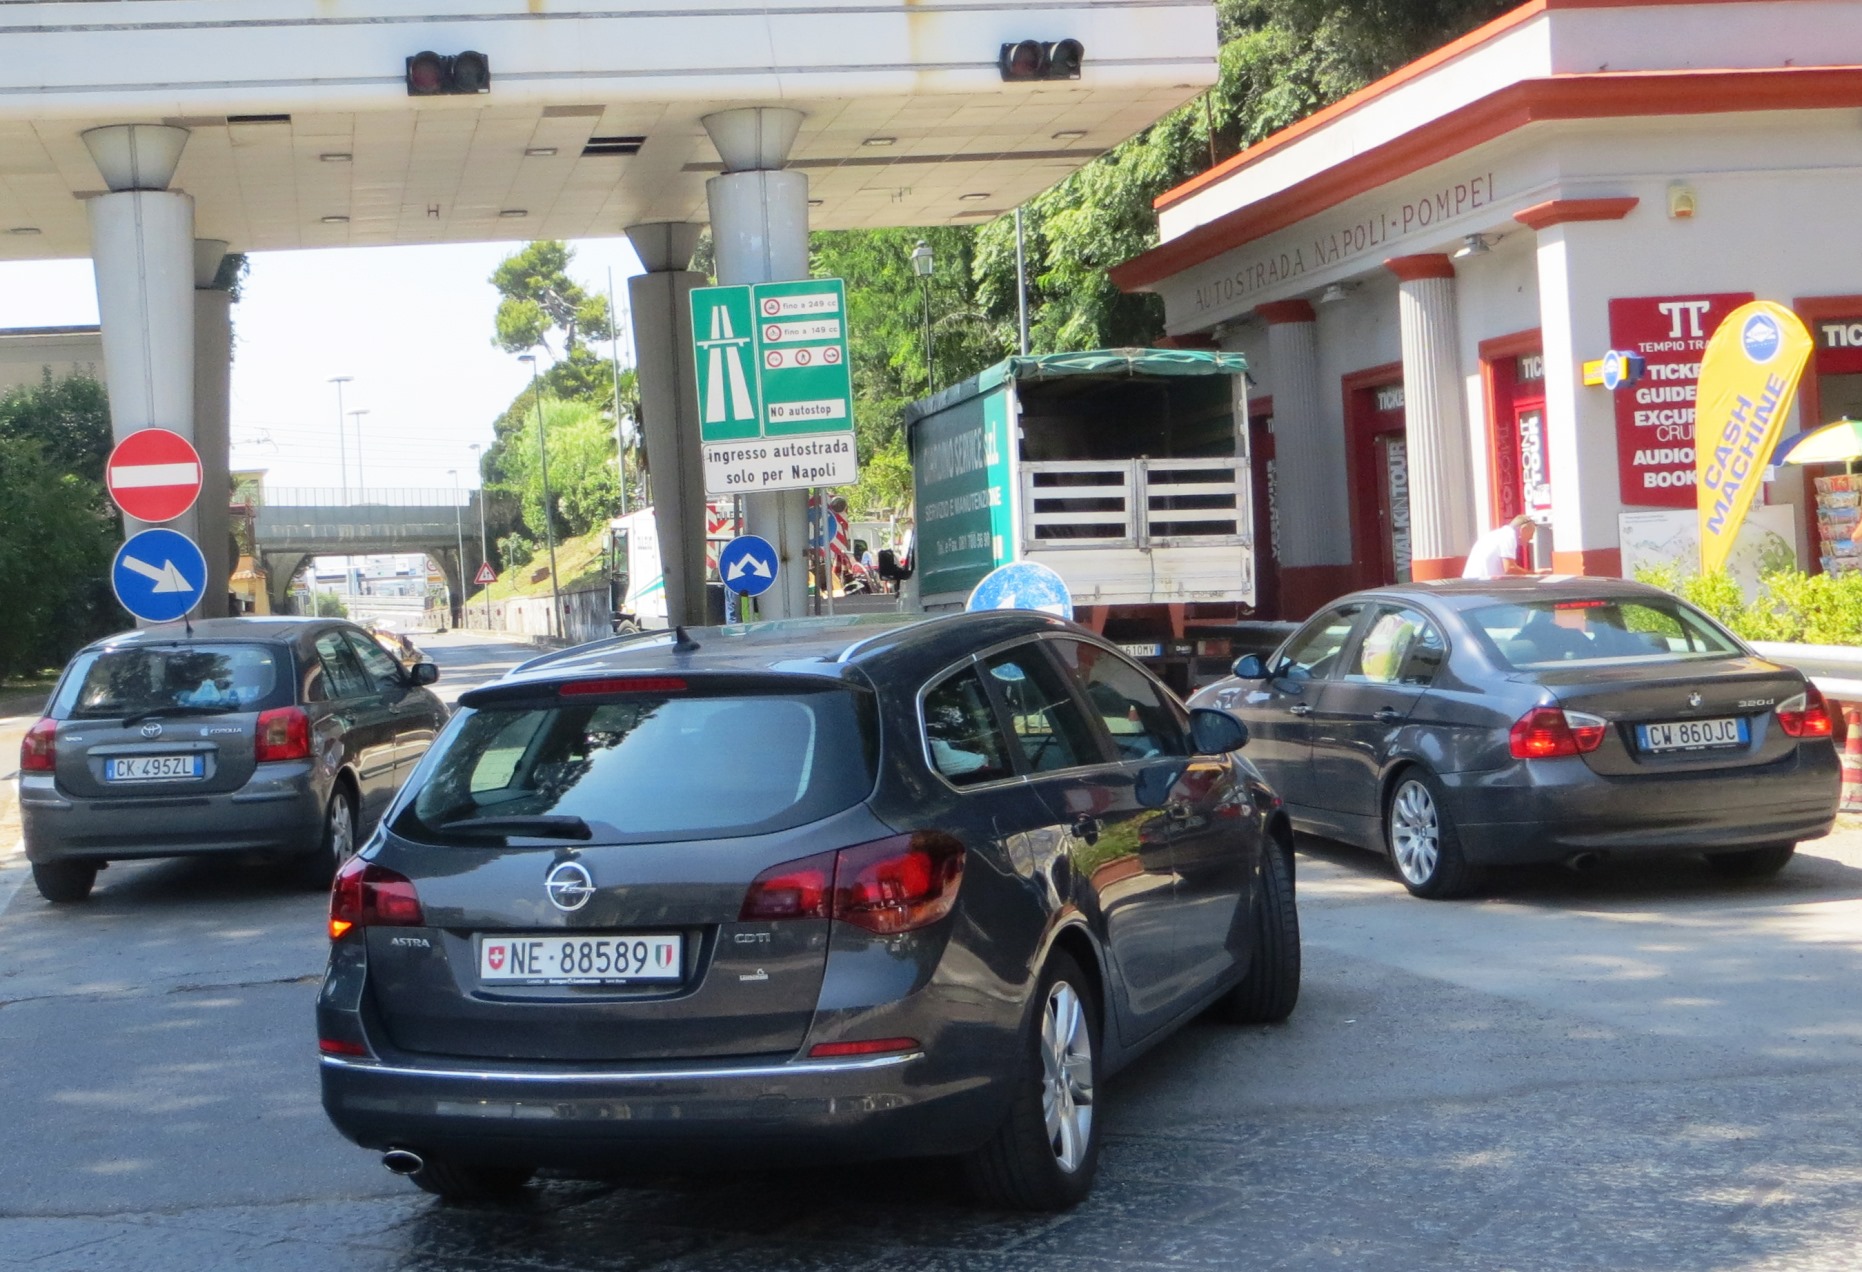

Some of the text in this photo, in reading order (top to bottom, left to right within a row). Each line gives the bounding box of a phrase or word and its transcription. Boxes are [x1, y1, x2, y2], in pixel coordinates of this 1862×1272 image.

[1195, 248, 1305, 311] AUTOSTRADA
[782, 301, 798, 309] fino
[808, 299, 825, 308] 249
[811, 326, 826, 334] 149
[1638, 341, 1685, 353] TEMPIO
[770, 405, 832, 417] NO autostop
[1703, 394, 1754, 491] CASH
[708, 438, 849, 465] ingresso autostrada
[1632, 447, 1696, 466] AUDIO
[1705, 372, 1788, 536] MACHINE
[726, 462, 837, 485] solo per Napoli
[1738, 698, 1774, 708] 320d
[390, 937, 431, 948] ASTRA
